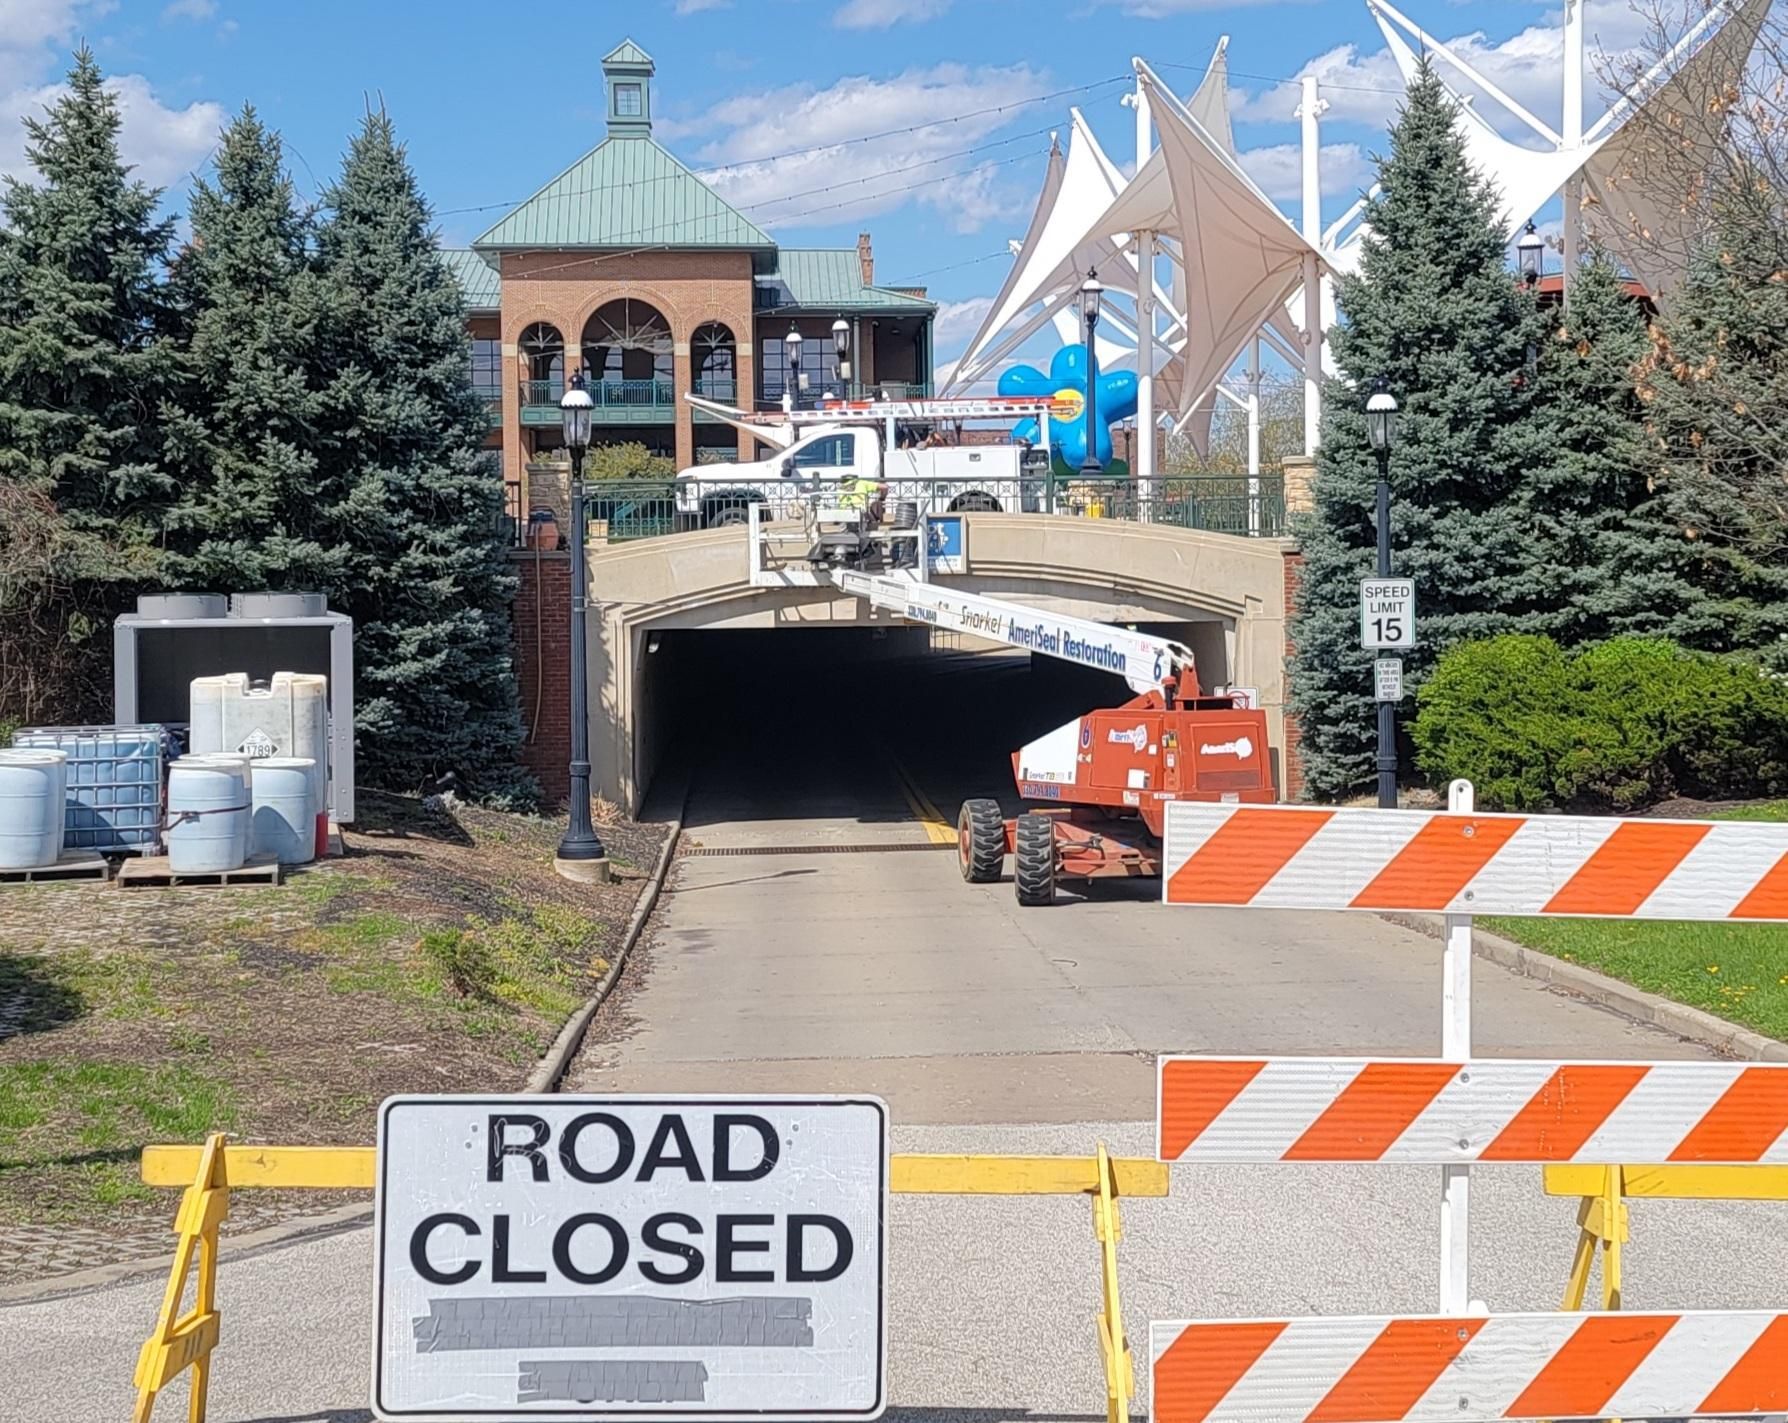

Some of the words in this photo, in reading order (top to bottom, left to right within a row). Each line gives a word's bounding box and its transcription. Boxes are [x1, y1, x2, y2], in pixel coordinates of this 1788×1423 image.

[1365, 586, 1410, 598] SPEED
[1370, 602, 1405, 613] LIMIT
[1371, 617, 1403, 642] 15
[1008, 618, 1060, 654] AmeriSeal
[1063, 630, 1126, 672] Restoration
[1153, 651, 1162, 681] 6
[1082, 720, 1090, 747] 6
[247, 744, 270, 757] 1789
[487, 1112, 780, 1184] ROAD
[409, 1212, 854, 1285] CLOSED
